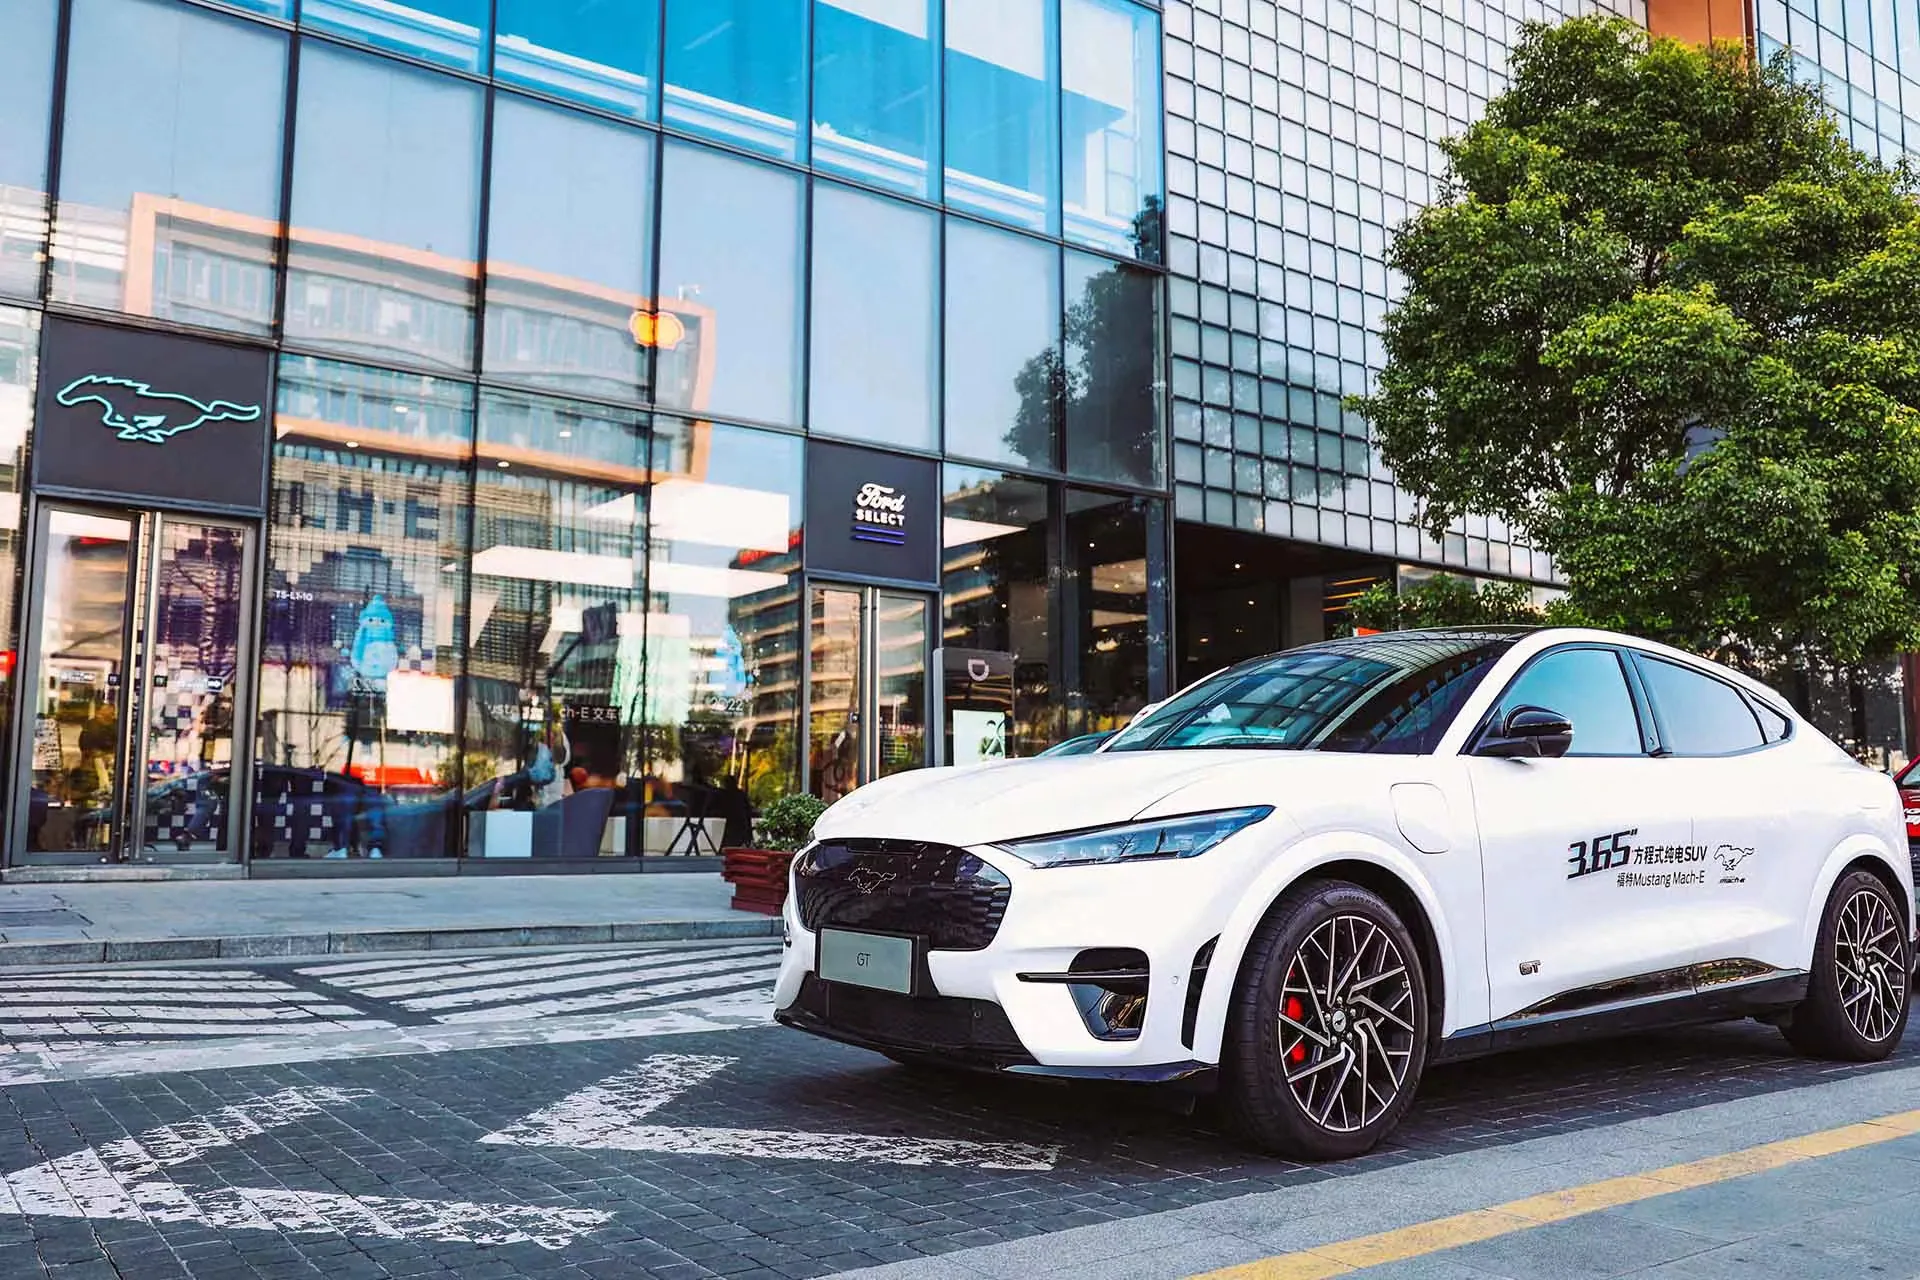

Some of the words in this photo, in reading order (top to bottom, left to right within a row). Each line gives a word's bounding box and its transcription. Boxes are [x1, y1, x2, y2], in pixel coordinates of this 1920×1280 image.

[857, 483, 906, 512] Ford
[856, 509, 905, 526] SELECT
[1633, 846, 1708, 865] 方程式纯电SUV
[1617, 872, 1671, 888] 福特Mustang
[1673, 870, 1706, 886] Mach-E
[857, 952, 871, 967] GT
[1519, 960, 1541, 975] GT
